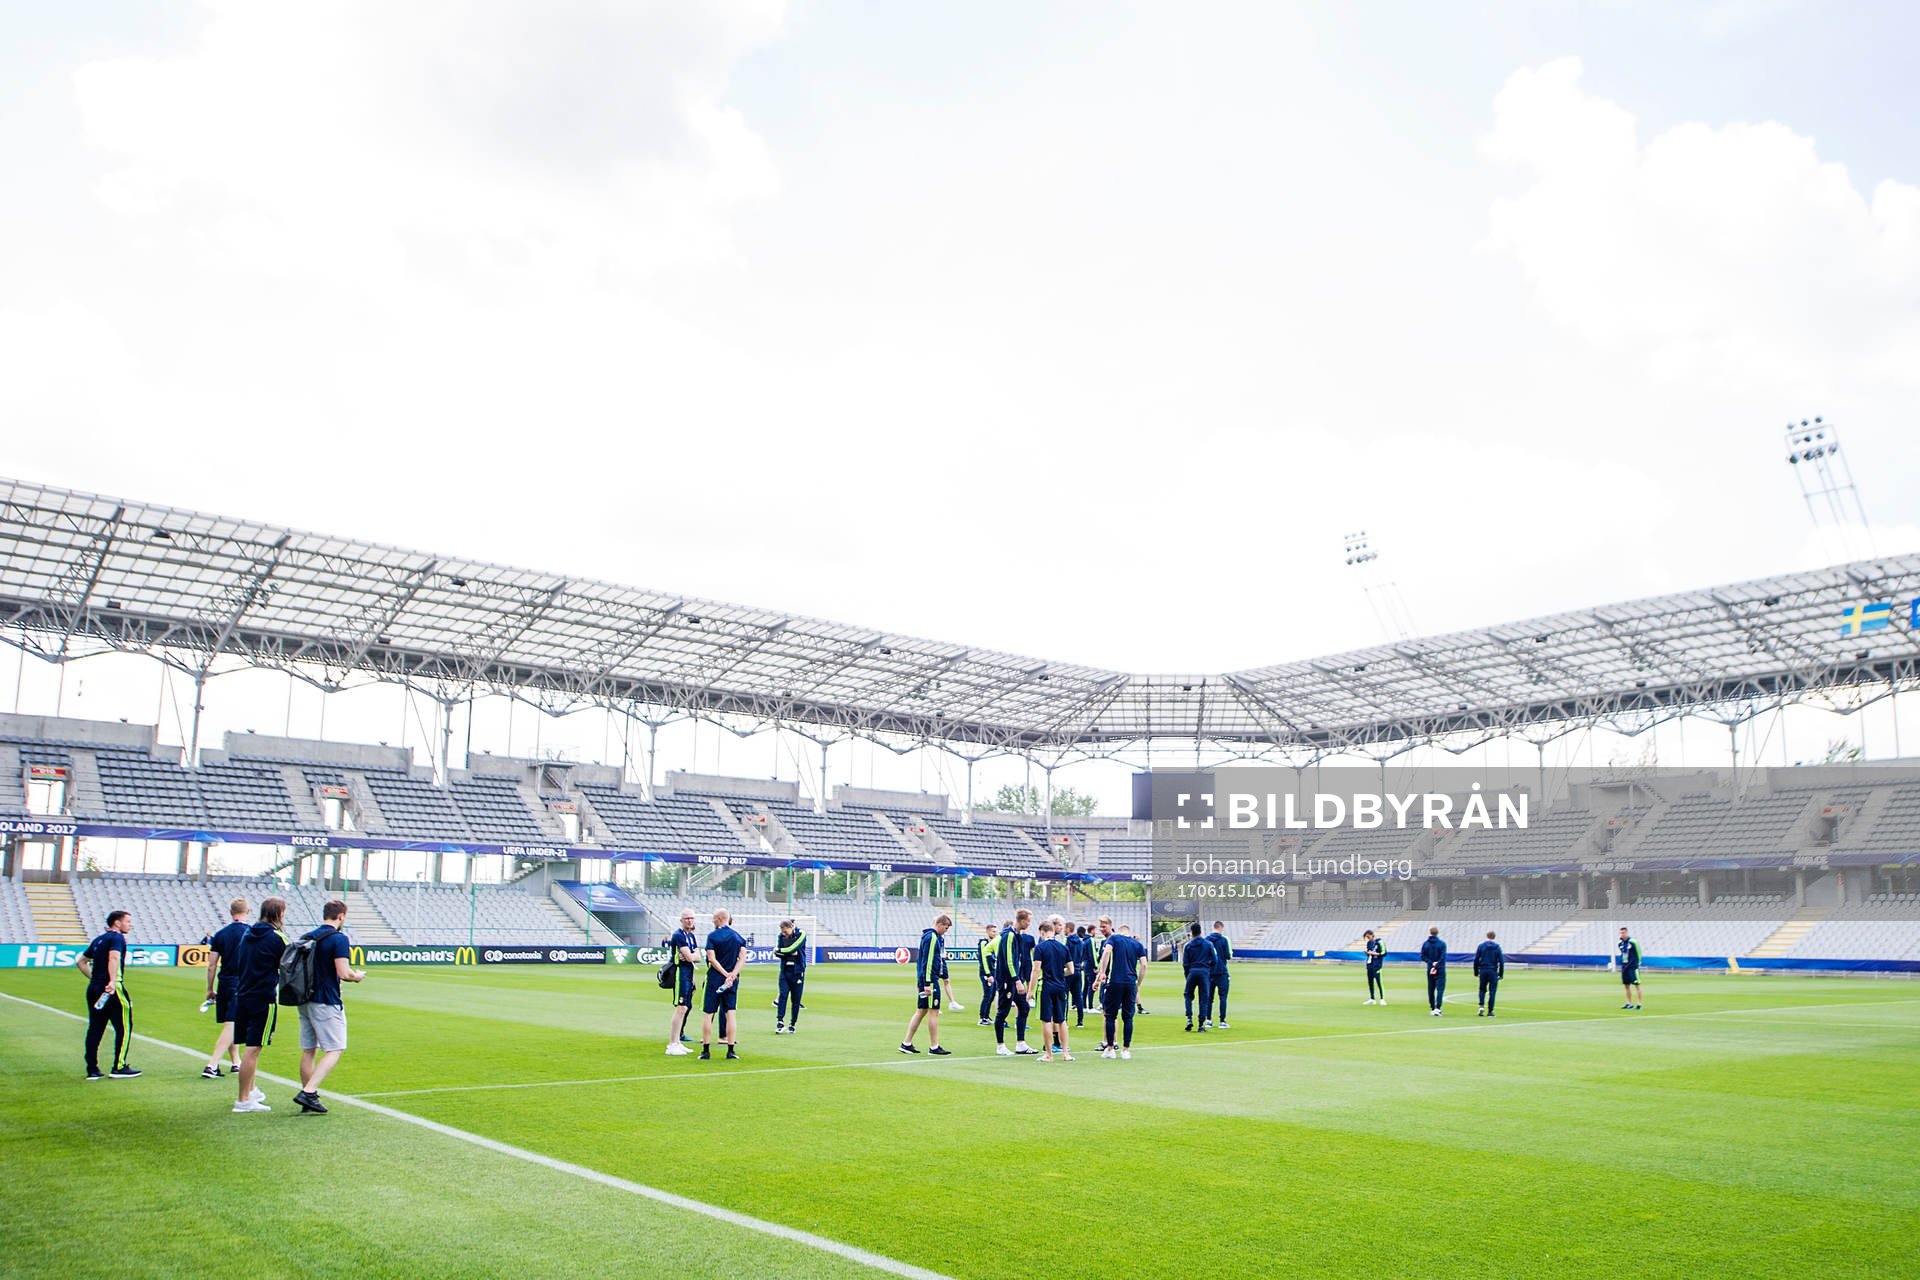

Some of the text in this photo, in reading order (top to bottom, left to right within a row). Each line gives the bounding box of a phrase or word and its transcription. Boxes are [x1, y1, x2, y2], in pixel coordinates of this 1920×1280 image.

[0, 821, 78, 835] OLAND 2017
[291, 836, 329, 847] KIELCE
[502, 846, 567, 857] UEFA UNDER-21
[698, 855, 747, 865] POLAND 2017
[869, 863, 892, 871] KIELCE
[17, 945, 170, 967] Hisse
[366, 950, 455, 962] McDonald's
[828, 951, 895, 960] TURKISH AIRLINES
